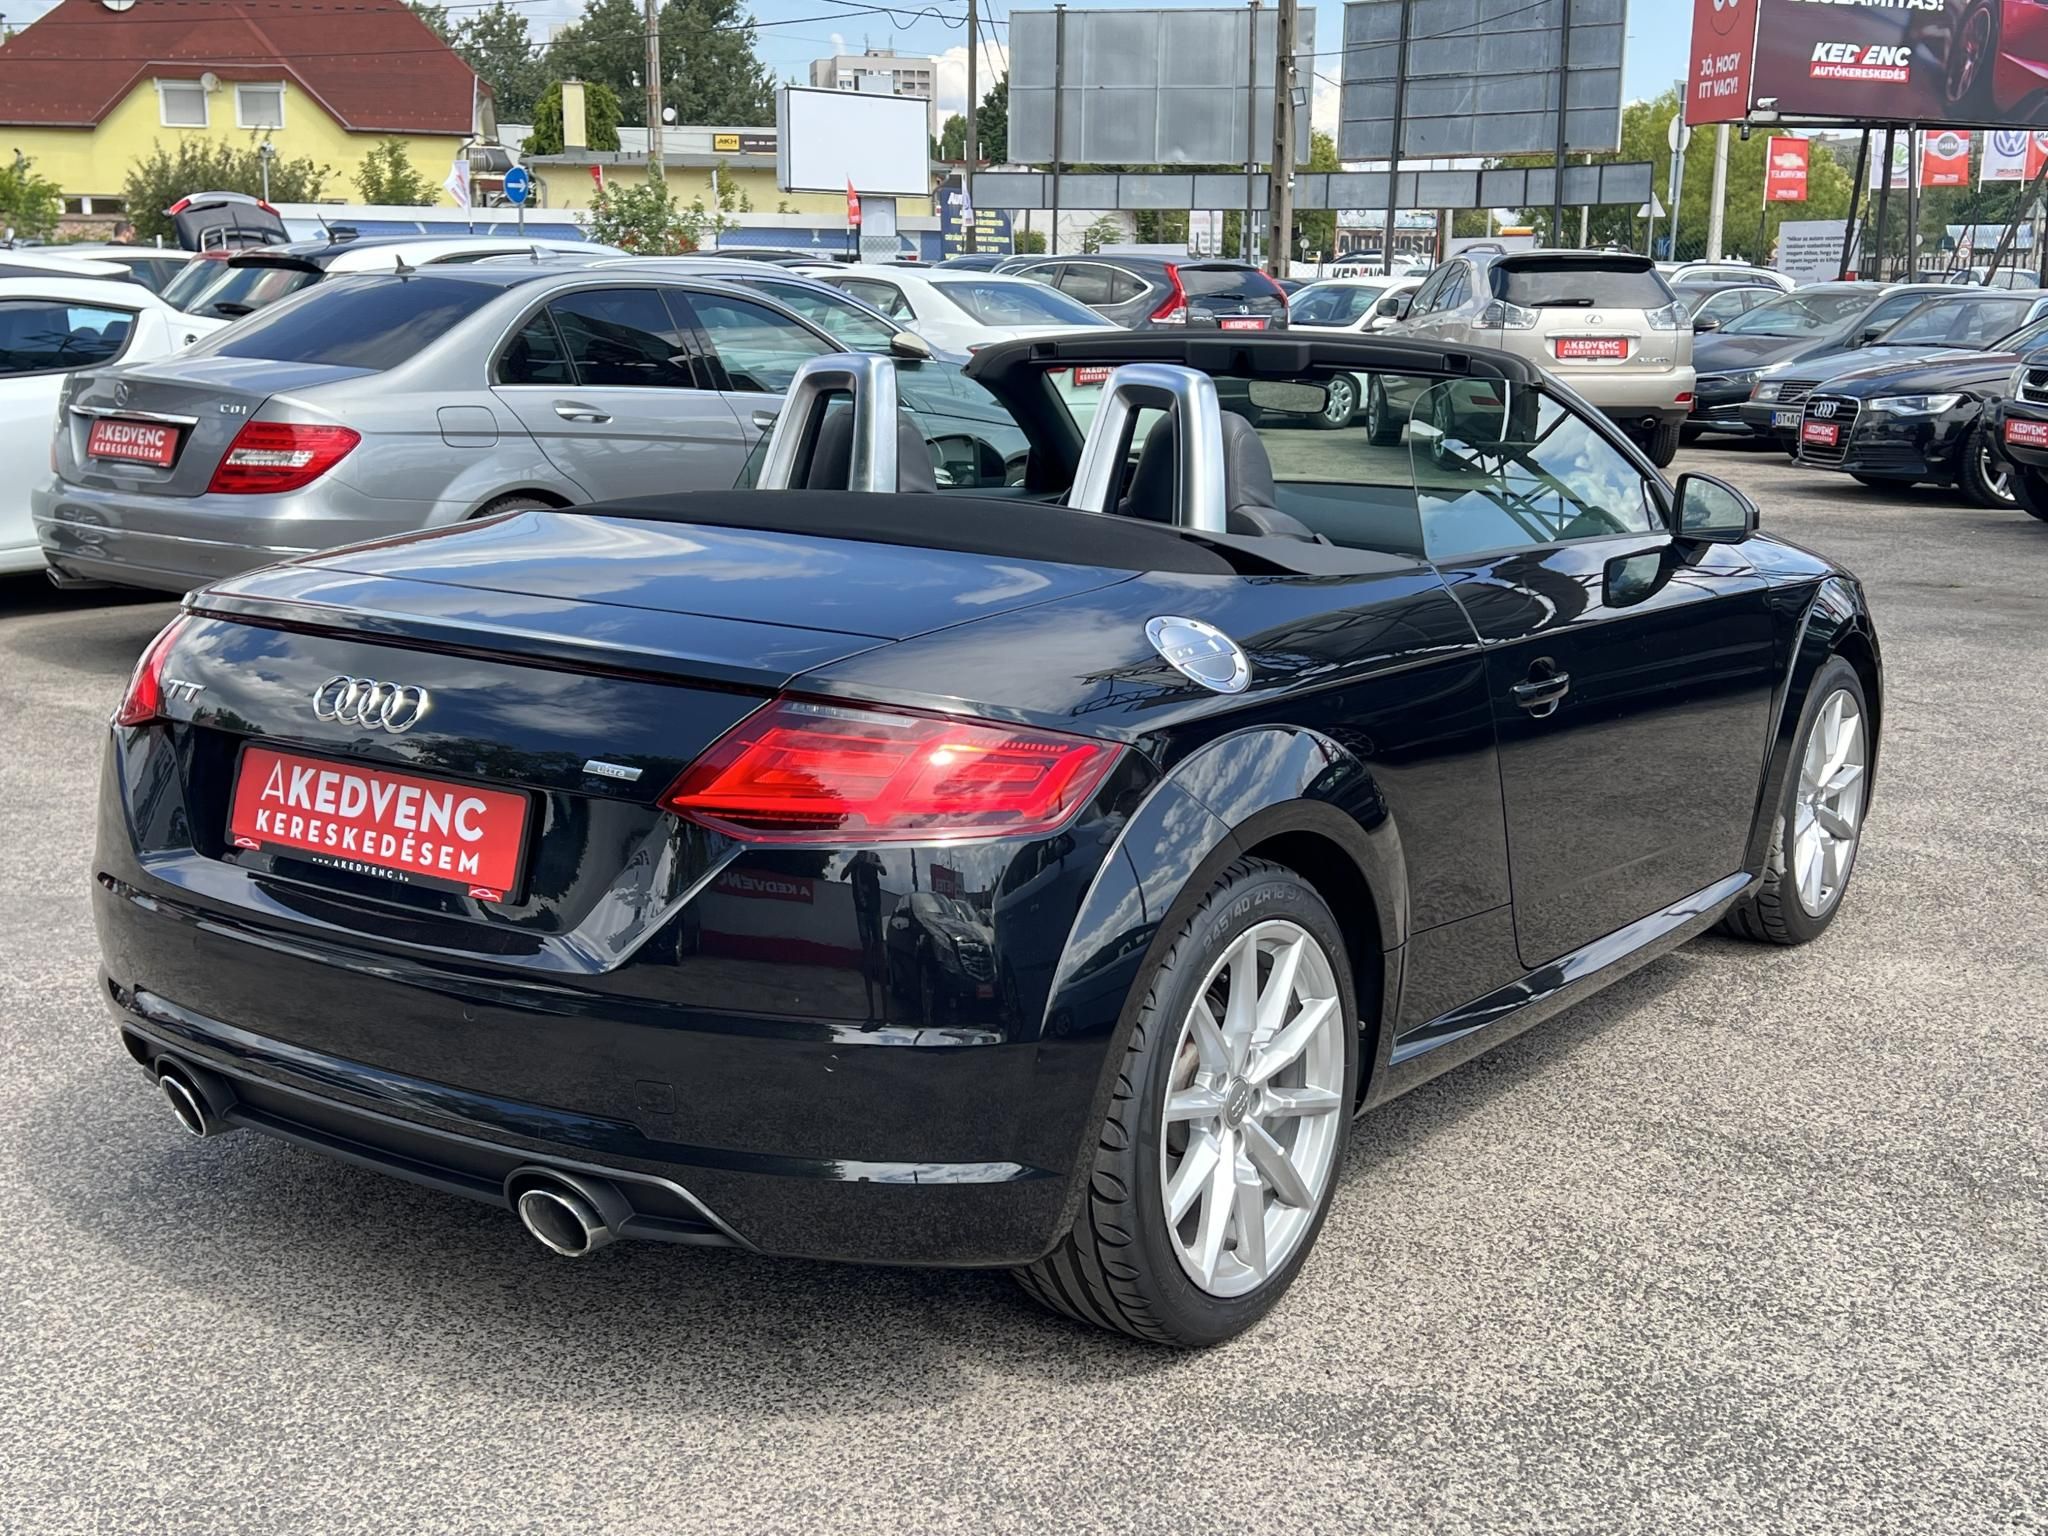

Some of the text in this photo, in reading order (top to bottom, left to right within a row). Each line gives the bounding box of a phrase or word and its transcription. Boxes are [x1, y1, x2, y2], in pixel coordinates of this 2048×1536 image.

[1700, 52, 1741, 77] JÓ, HOGY
[1813, 65, 1906, 80] AUTÓKERESKEDÉS
[1699, 77, 1738, 99] ITT VAGY!
[219, 404, 247, 415] CDI
[168, 679, 207, 702] TT
[255, 808, 480, 876] KERESKEDÉSEM
